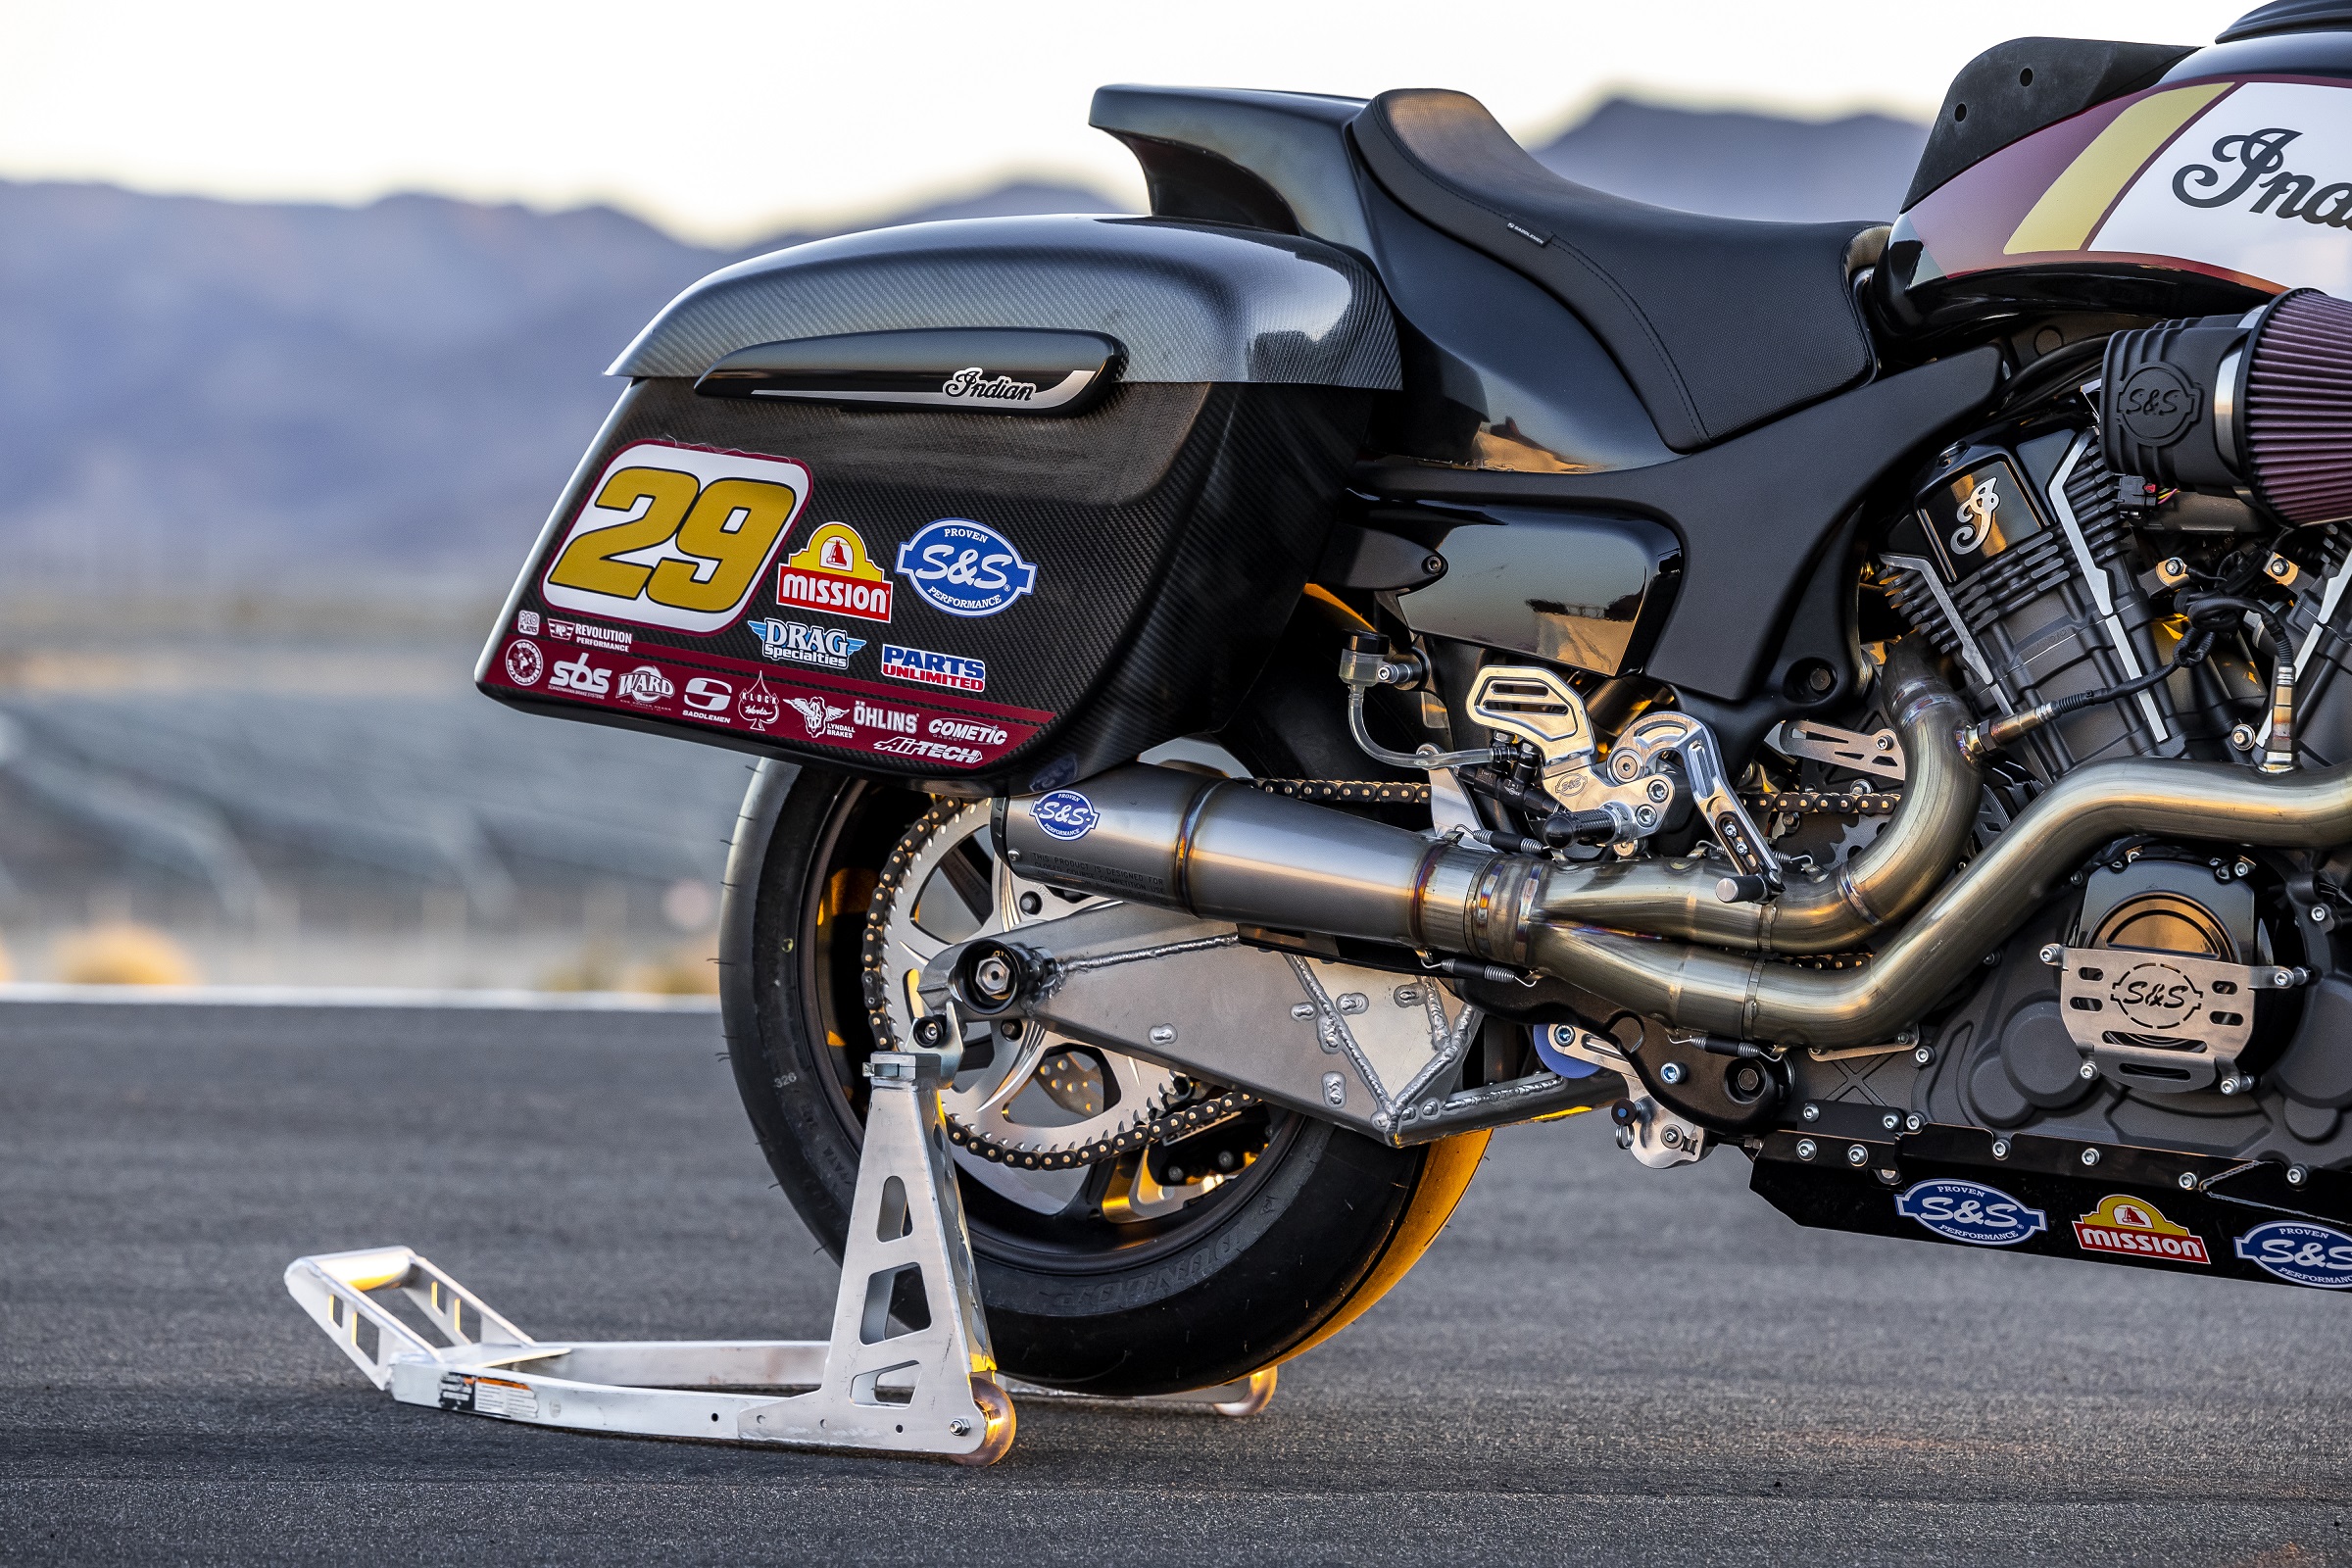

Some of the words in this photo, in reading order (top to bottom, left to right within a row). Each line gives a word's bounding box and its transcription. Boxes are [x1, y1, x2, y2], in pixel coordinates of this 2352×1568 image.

[946, 370, 1034, 401] Indian
[2126, 388, 2181, 416] S&S
[547, 466, 797, 613] 29
[944, 527, 988, 543] PROVEN
[914, 544, 1013, 590] S&S
[927, 584, 1003, 610] PERFORMANCE
[520, 612, 537, 625] PRO
[574, 622, 632, 645] REVOLUTION
[576, 636, 630, 653] PERFORMANCE
[765, 620, 849, 658] DRAG
[764, 643, 847, 667] Specialties
[883, 646, 985, 679] PARTS
[617, 673, 675, 697] WARD
[882, 663, 984, 692] UNLIMITED
[682, 710, 731, 724] SADDLEMEN
[827, 722, 856, 733] LYNDALL
[853, 700, 918, 734] ÖHLINS
[826, 729, 854, 739] BRAKES
[928, 718, 1008, 745] COMETIC
[1057, 793, 1081, 803] PROVEN
[1039, 801, 1090, 826] S&S
[1044, 822, 1080, 836] PERFORMANCE
[1032, 852, 1050, 862] THIS
[1054, 857, 1090, 871] PRODUCT
[1106, 867, 1144, 882] DESIGNED
[1148, 876, 1164, 886] FOR
[1100, 875, 1147, 891] COMPETITION
[2122, 981, 2189, 1009] S&S
[1936, 1185, 1985, 1198] PROVEN
[1920, 1197, 2019, 1228] S&S
[1939, 1224, 2019, 1241] PERFORMANCE
[2278, 1227, 2330, 1240] PROVEN
[2259, 1239, 2352, 1271] S&S
